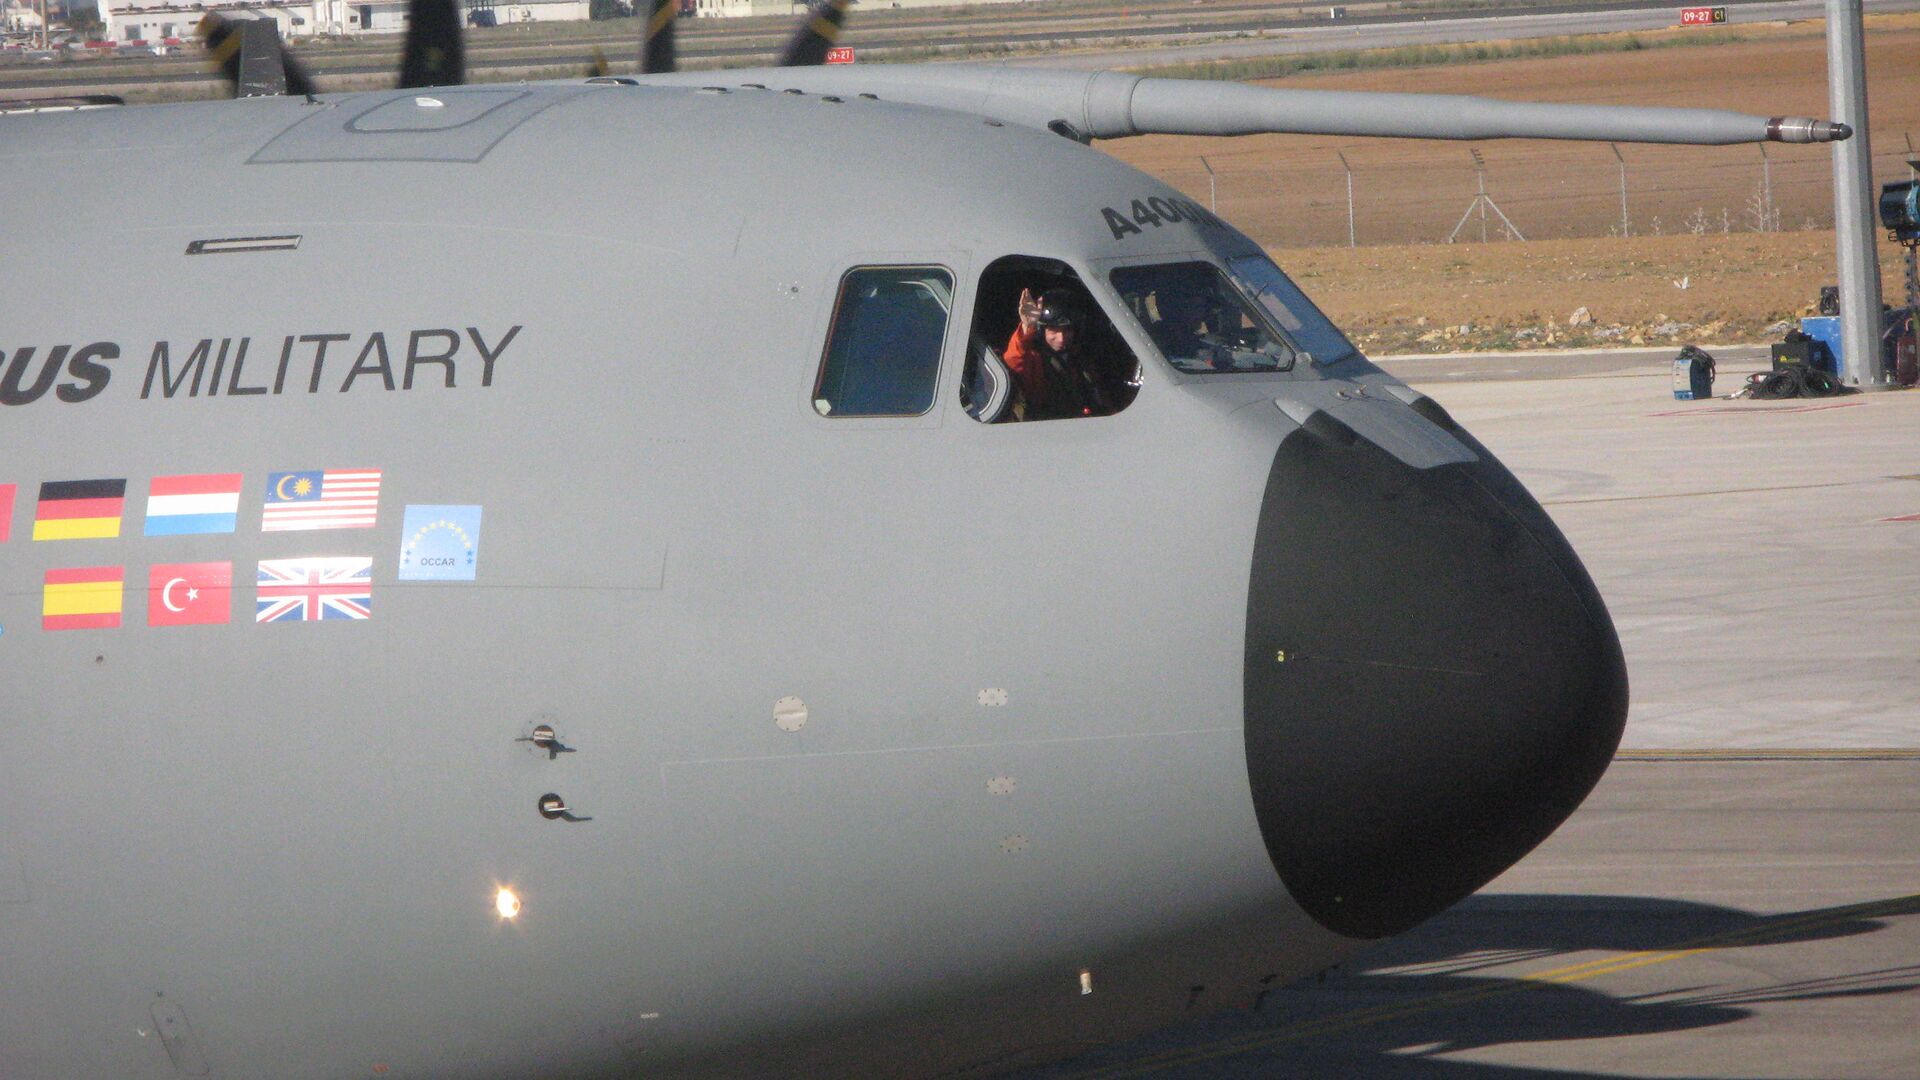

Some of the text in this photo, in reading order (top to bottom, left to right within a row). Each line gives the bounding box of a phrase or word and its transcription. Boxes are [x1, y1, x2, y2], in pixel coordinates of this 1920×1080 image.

[1683, 11, 1710, 22] 09-27
[827, 50, 850, 60] 09-27
[0, 325, 523, 406] US MILITARY
[420, 557, 456, 567] OCCAR
